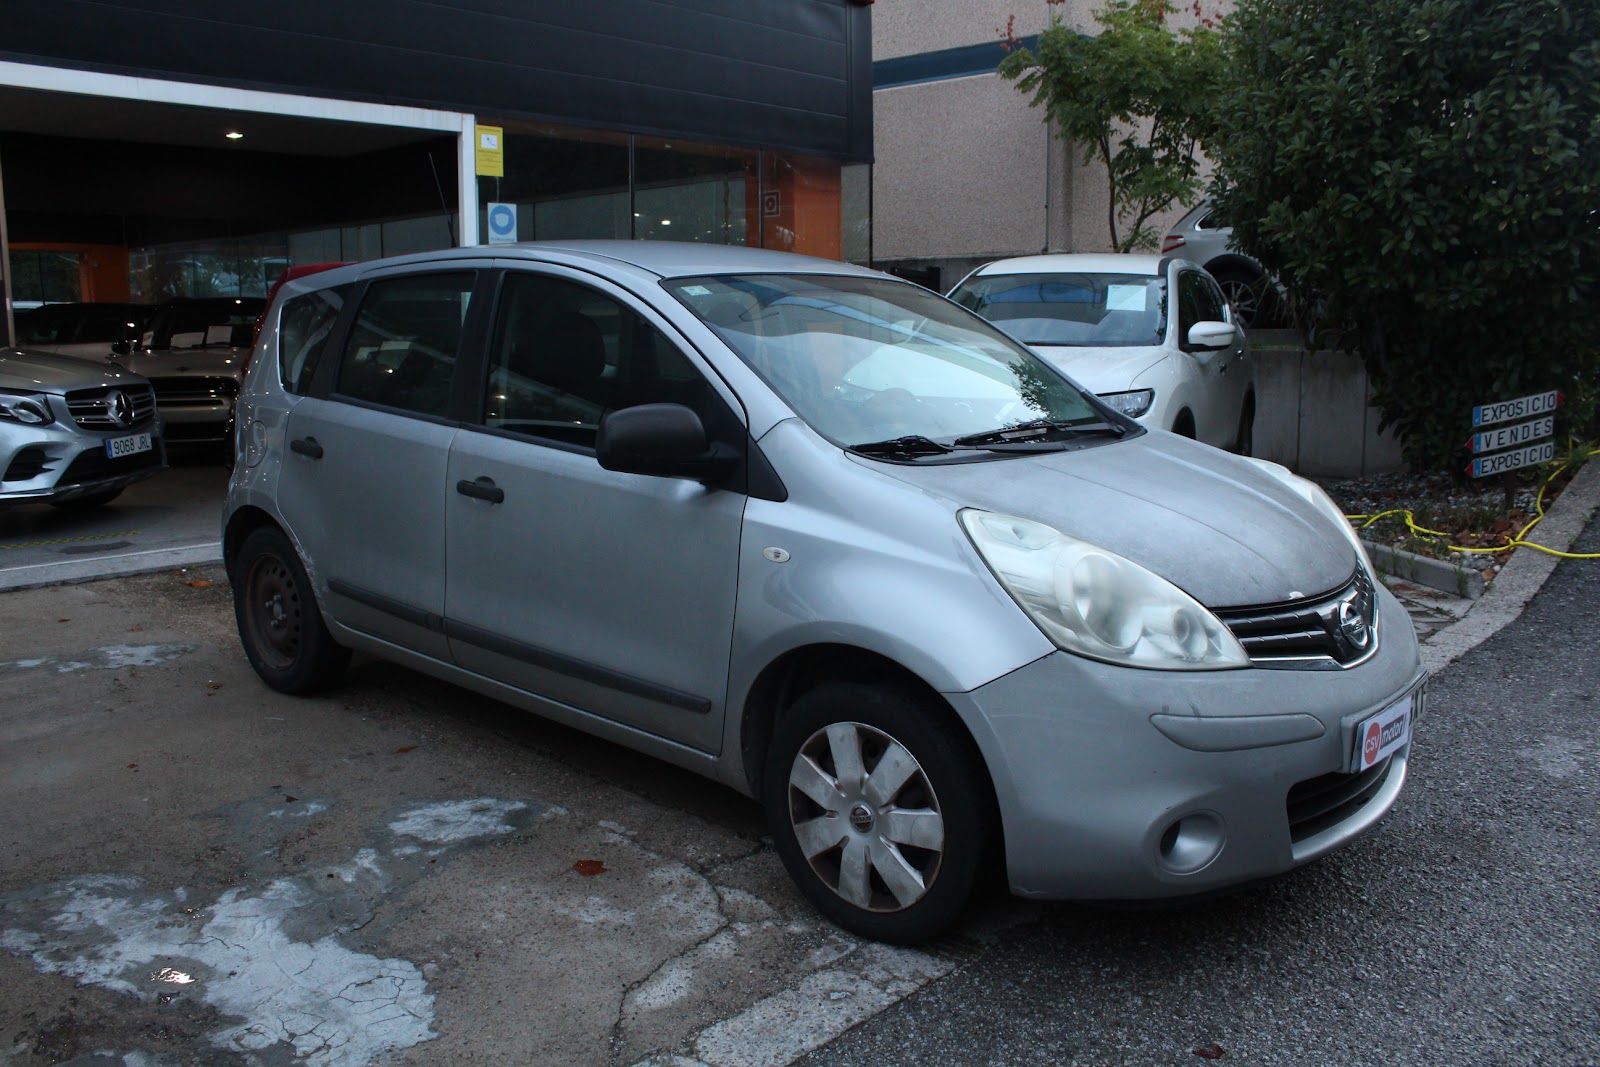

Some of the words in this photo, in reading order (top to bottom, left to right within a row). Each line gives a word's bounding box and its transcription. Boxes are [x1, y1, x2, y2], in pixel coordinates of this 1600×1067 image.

[1481, 393, 1556, 423] EXPOSICIO
[113, 437, 135, 455] 9068
[137, 435, 150, 450] JRL
[1484, 419, 1552, 449] VENDES
[1481, 444, 1553, 475] EXPOSICIO
